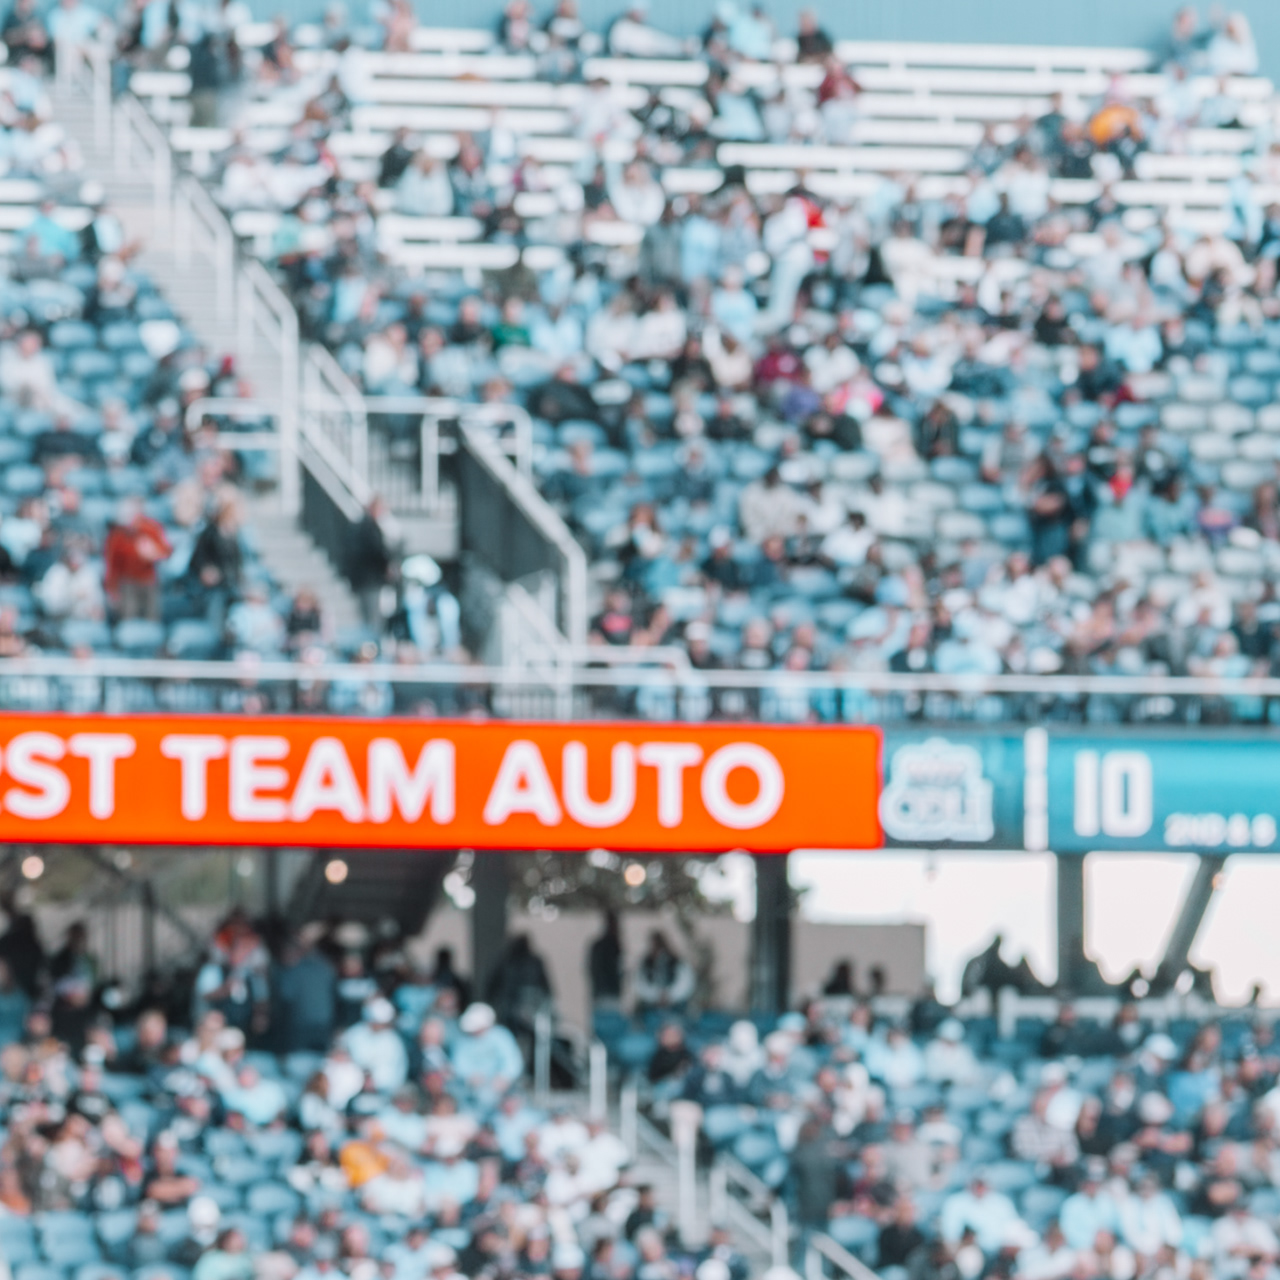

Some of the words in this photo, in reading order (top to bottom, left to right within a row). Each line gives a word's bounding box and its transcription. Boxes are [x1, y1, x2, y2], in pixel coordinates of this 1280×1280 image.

[160, 734, 456, 824] TEAM
[483, 740, 785, 830] AUTO
[1073, 749, 1153, 837] 10
